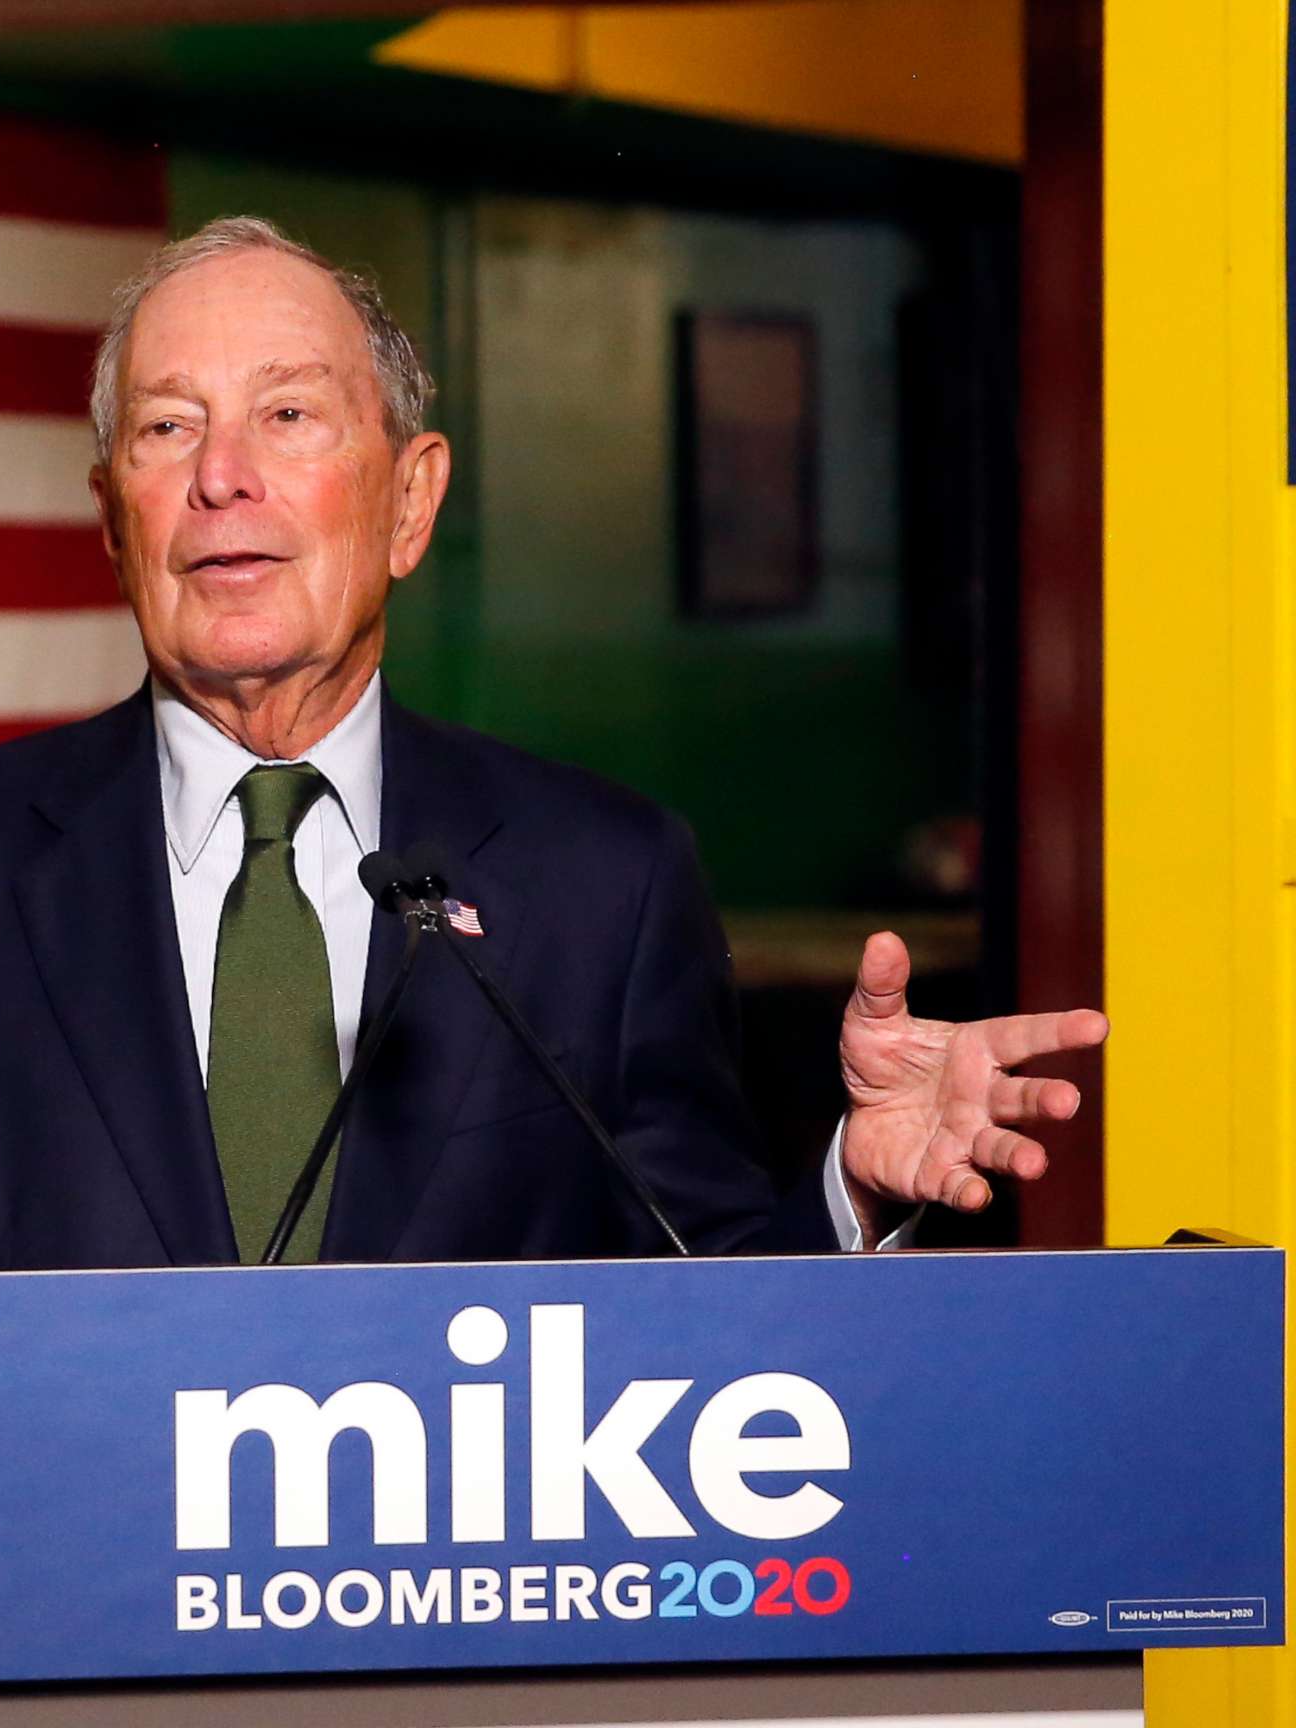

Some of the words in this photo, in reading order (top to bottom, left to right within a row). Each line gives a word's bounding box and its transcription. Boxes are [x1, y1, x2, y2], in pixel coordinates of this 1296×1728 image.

[175, 1304, 850, 1550] mike
[1119, 1610, 1138, 1620] Paid
[1138, 1610, 1150, 1620] for
[1151, 1610, 1162, 1621] by
[1163, 1609, 1184, 1620] Mike
[1184, 1608, 1231, 1620] Bloomberg
[1231, 1608, 1254, 1618] 2020
